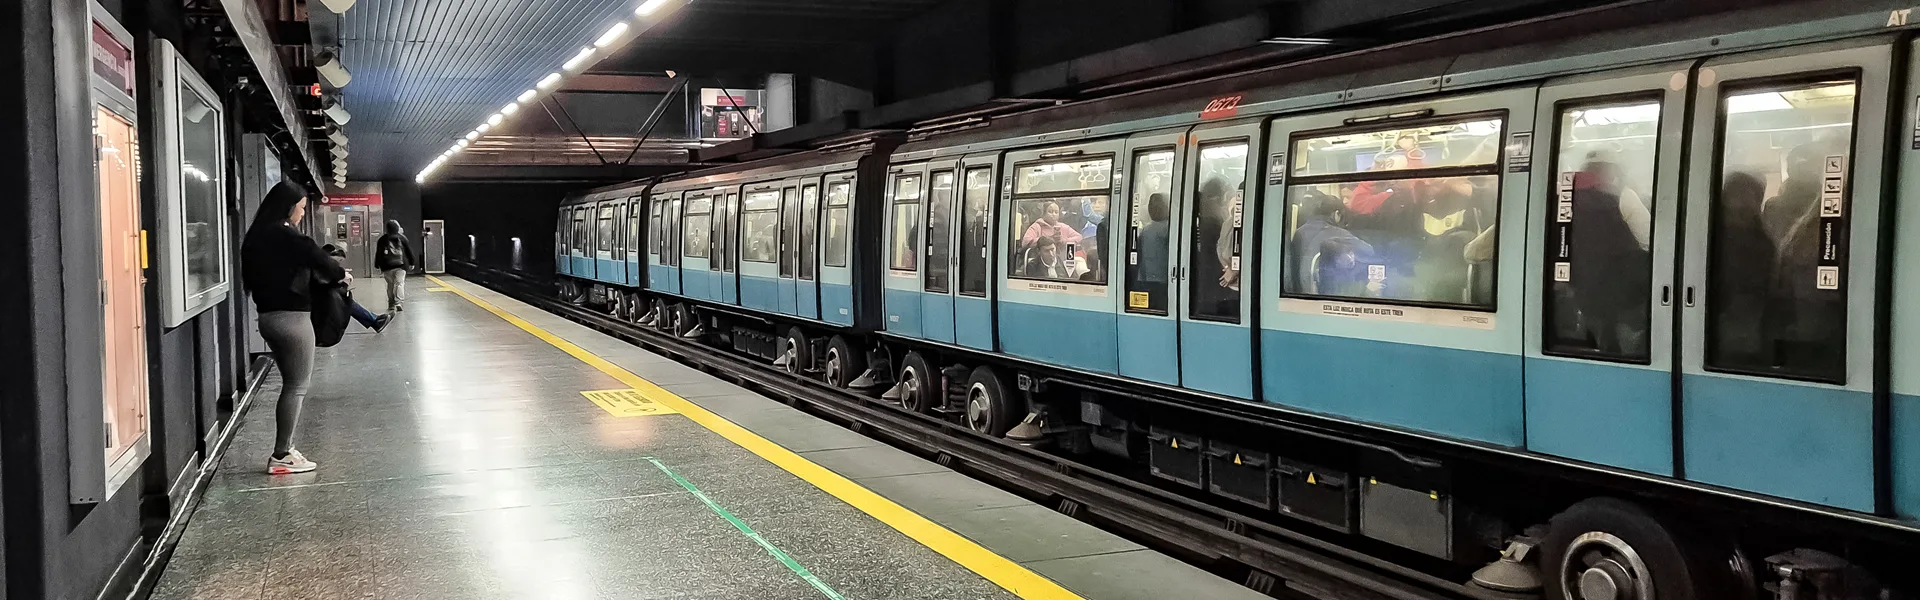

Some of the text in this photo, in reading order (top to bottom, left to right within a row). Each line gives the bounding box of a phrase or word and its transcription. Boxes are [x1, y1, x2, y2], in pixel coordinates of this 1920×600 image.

[1886, 8, 1911, 27] AT
[1203, 95, 1242, 113] 0673
[1823, 222, 1832, 260] Precaución
